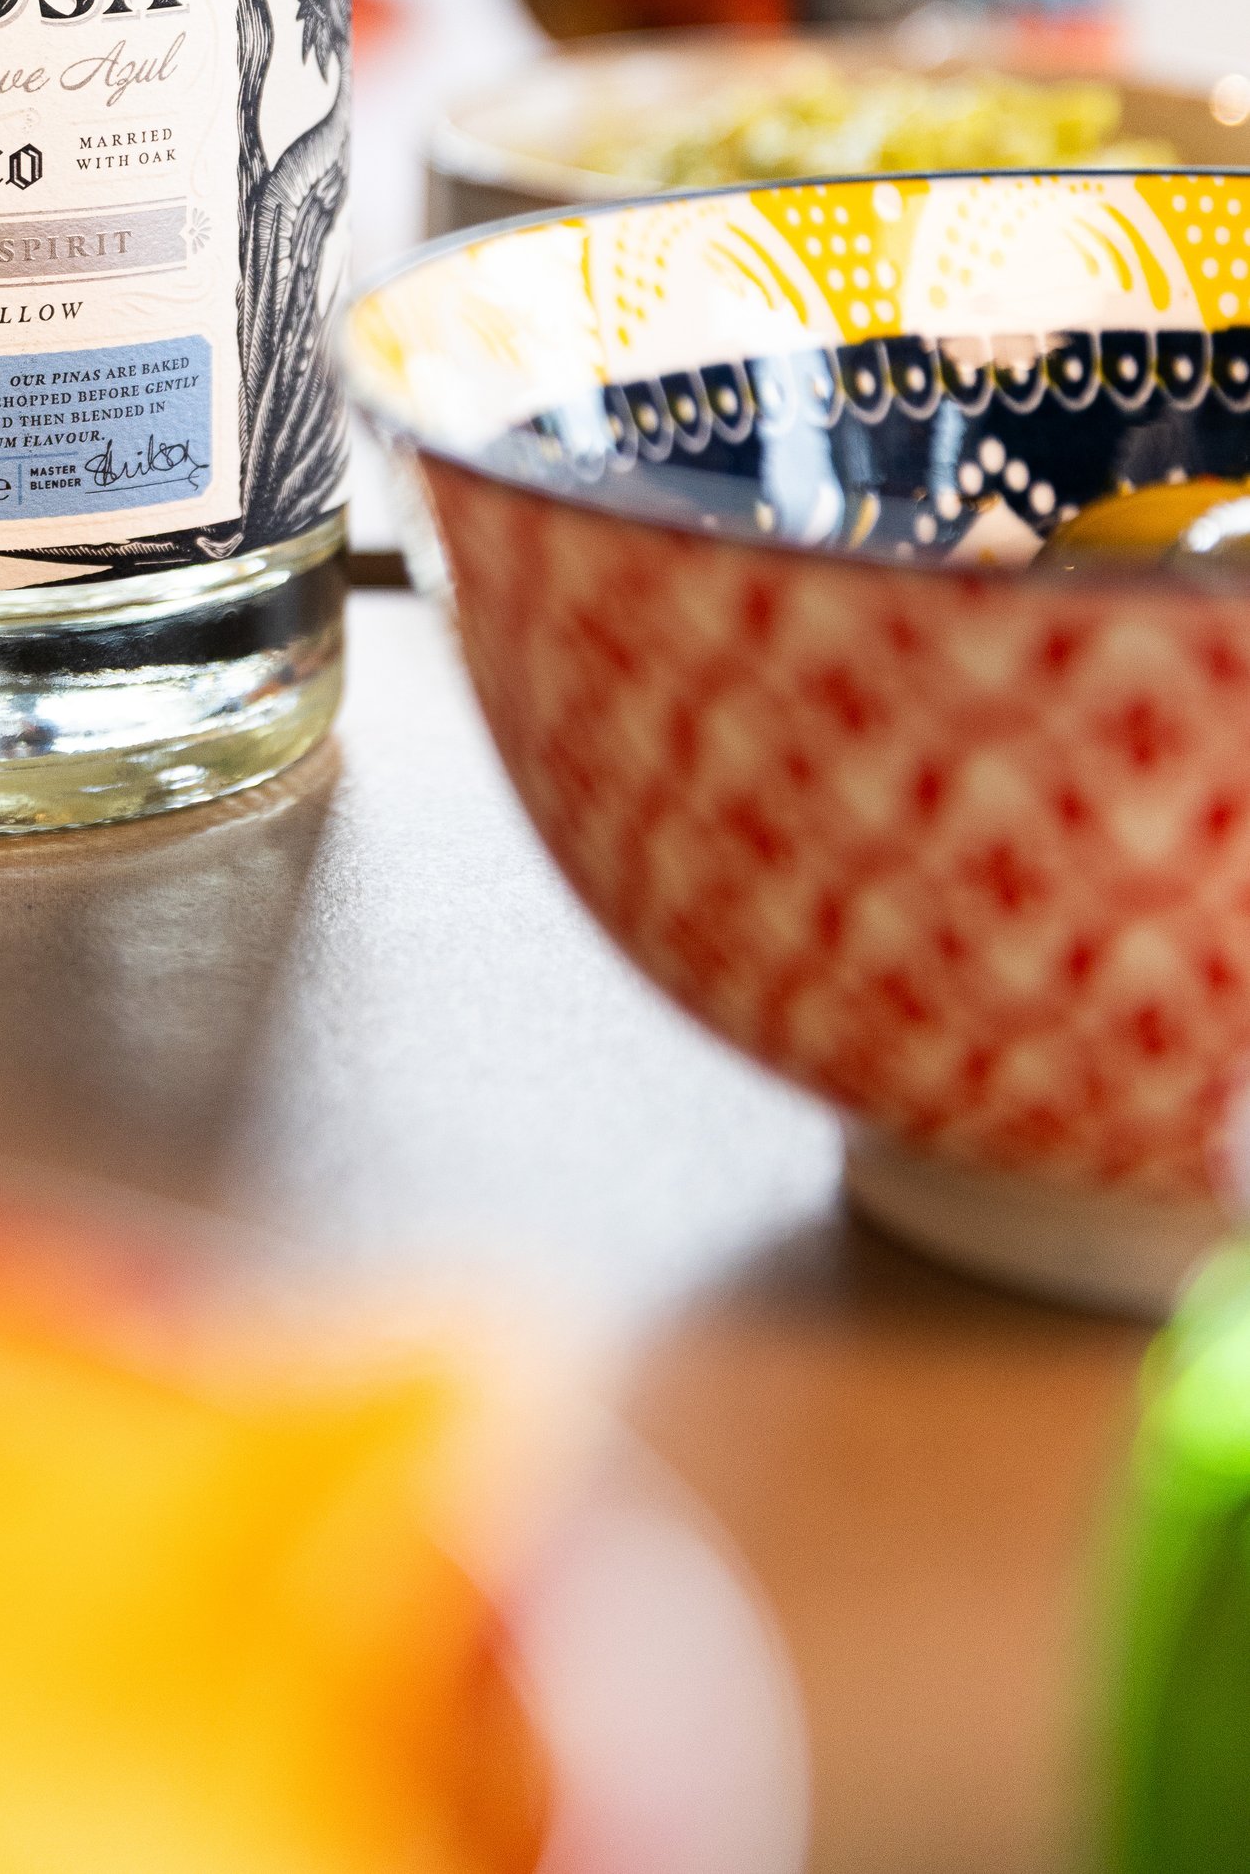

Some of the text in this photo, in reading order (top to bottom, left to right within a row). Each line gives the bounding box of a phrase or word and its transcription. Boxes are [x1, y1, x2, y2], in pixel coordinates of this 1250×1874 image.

[60, 31, 187, 107] Azul
[79, 127, 173, 150] MARRIED
[76, 149, 177, 171] WITH OAK
[10, 373, 46, 387] OUR
[51, 369, 101, 385] PINAS
[106, 365, 136, 380] ARE
[142, 357, 190, 375] BAKED
[78, 385, 139, 403] BEFORE
[145, 375, 200, 394] GENTLY
[20, 413, 65, 428] THEN
[71, 406, 145, 424] BLENDED
[150, 401, 166, 414] IN
[23, 430, 106, 448] FLAVOUR.
[30, 465, 76, 477] MASTER
[30, 477, 82, 491] BLENDER
